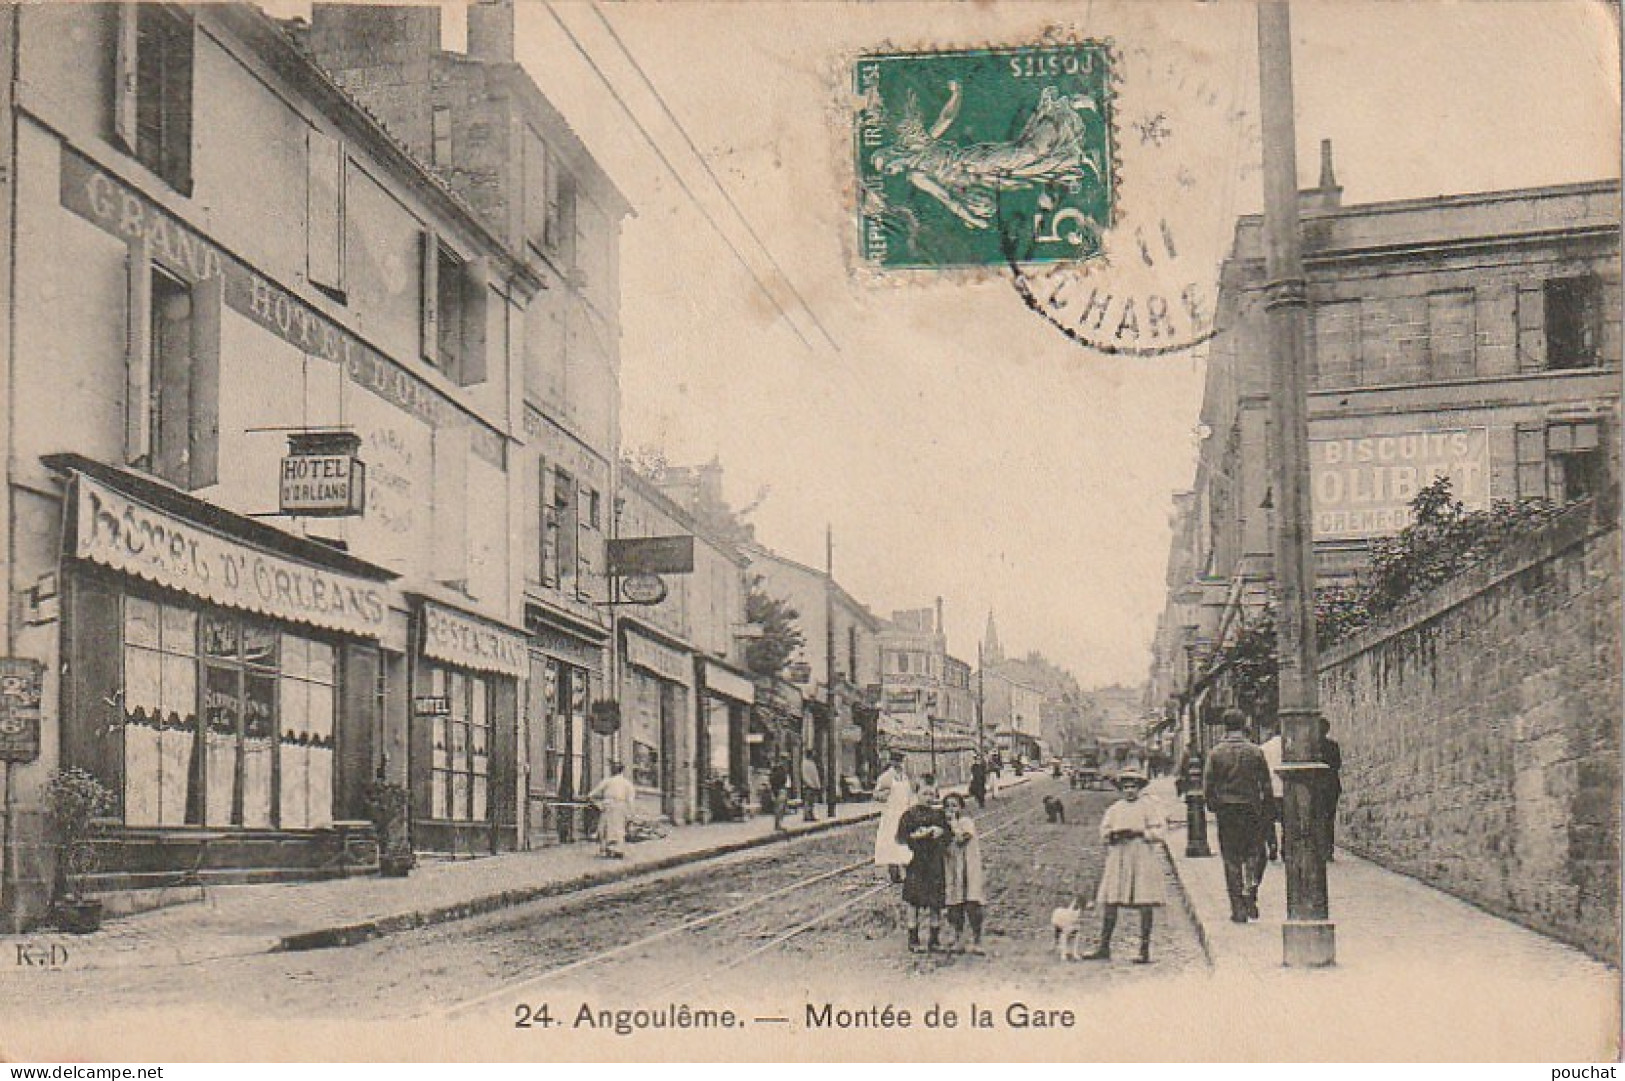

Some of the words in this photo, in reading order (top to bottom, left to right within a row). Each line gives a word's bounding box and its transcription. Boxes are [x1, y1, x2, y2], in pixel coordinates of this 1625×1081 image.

[1010, 53, 1093, 77] POSTES
[86, 173, 222, 279] GRAND
[1325, 433, 1469, 464] BISCUITS
